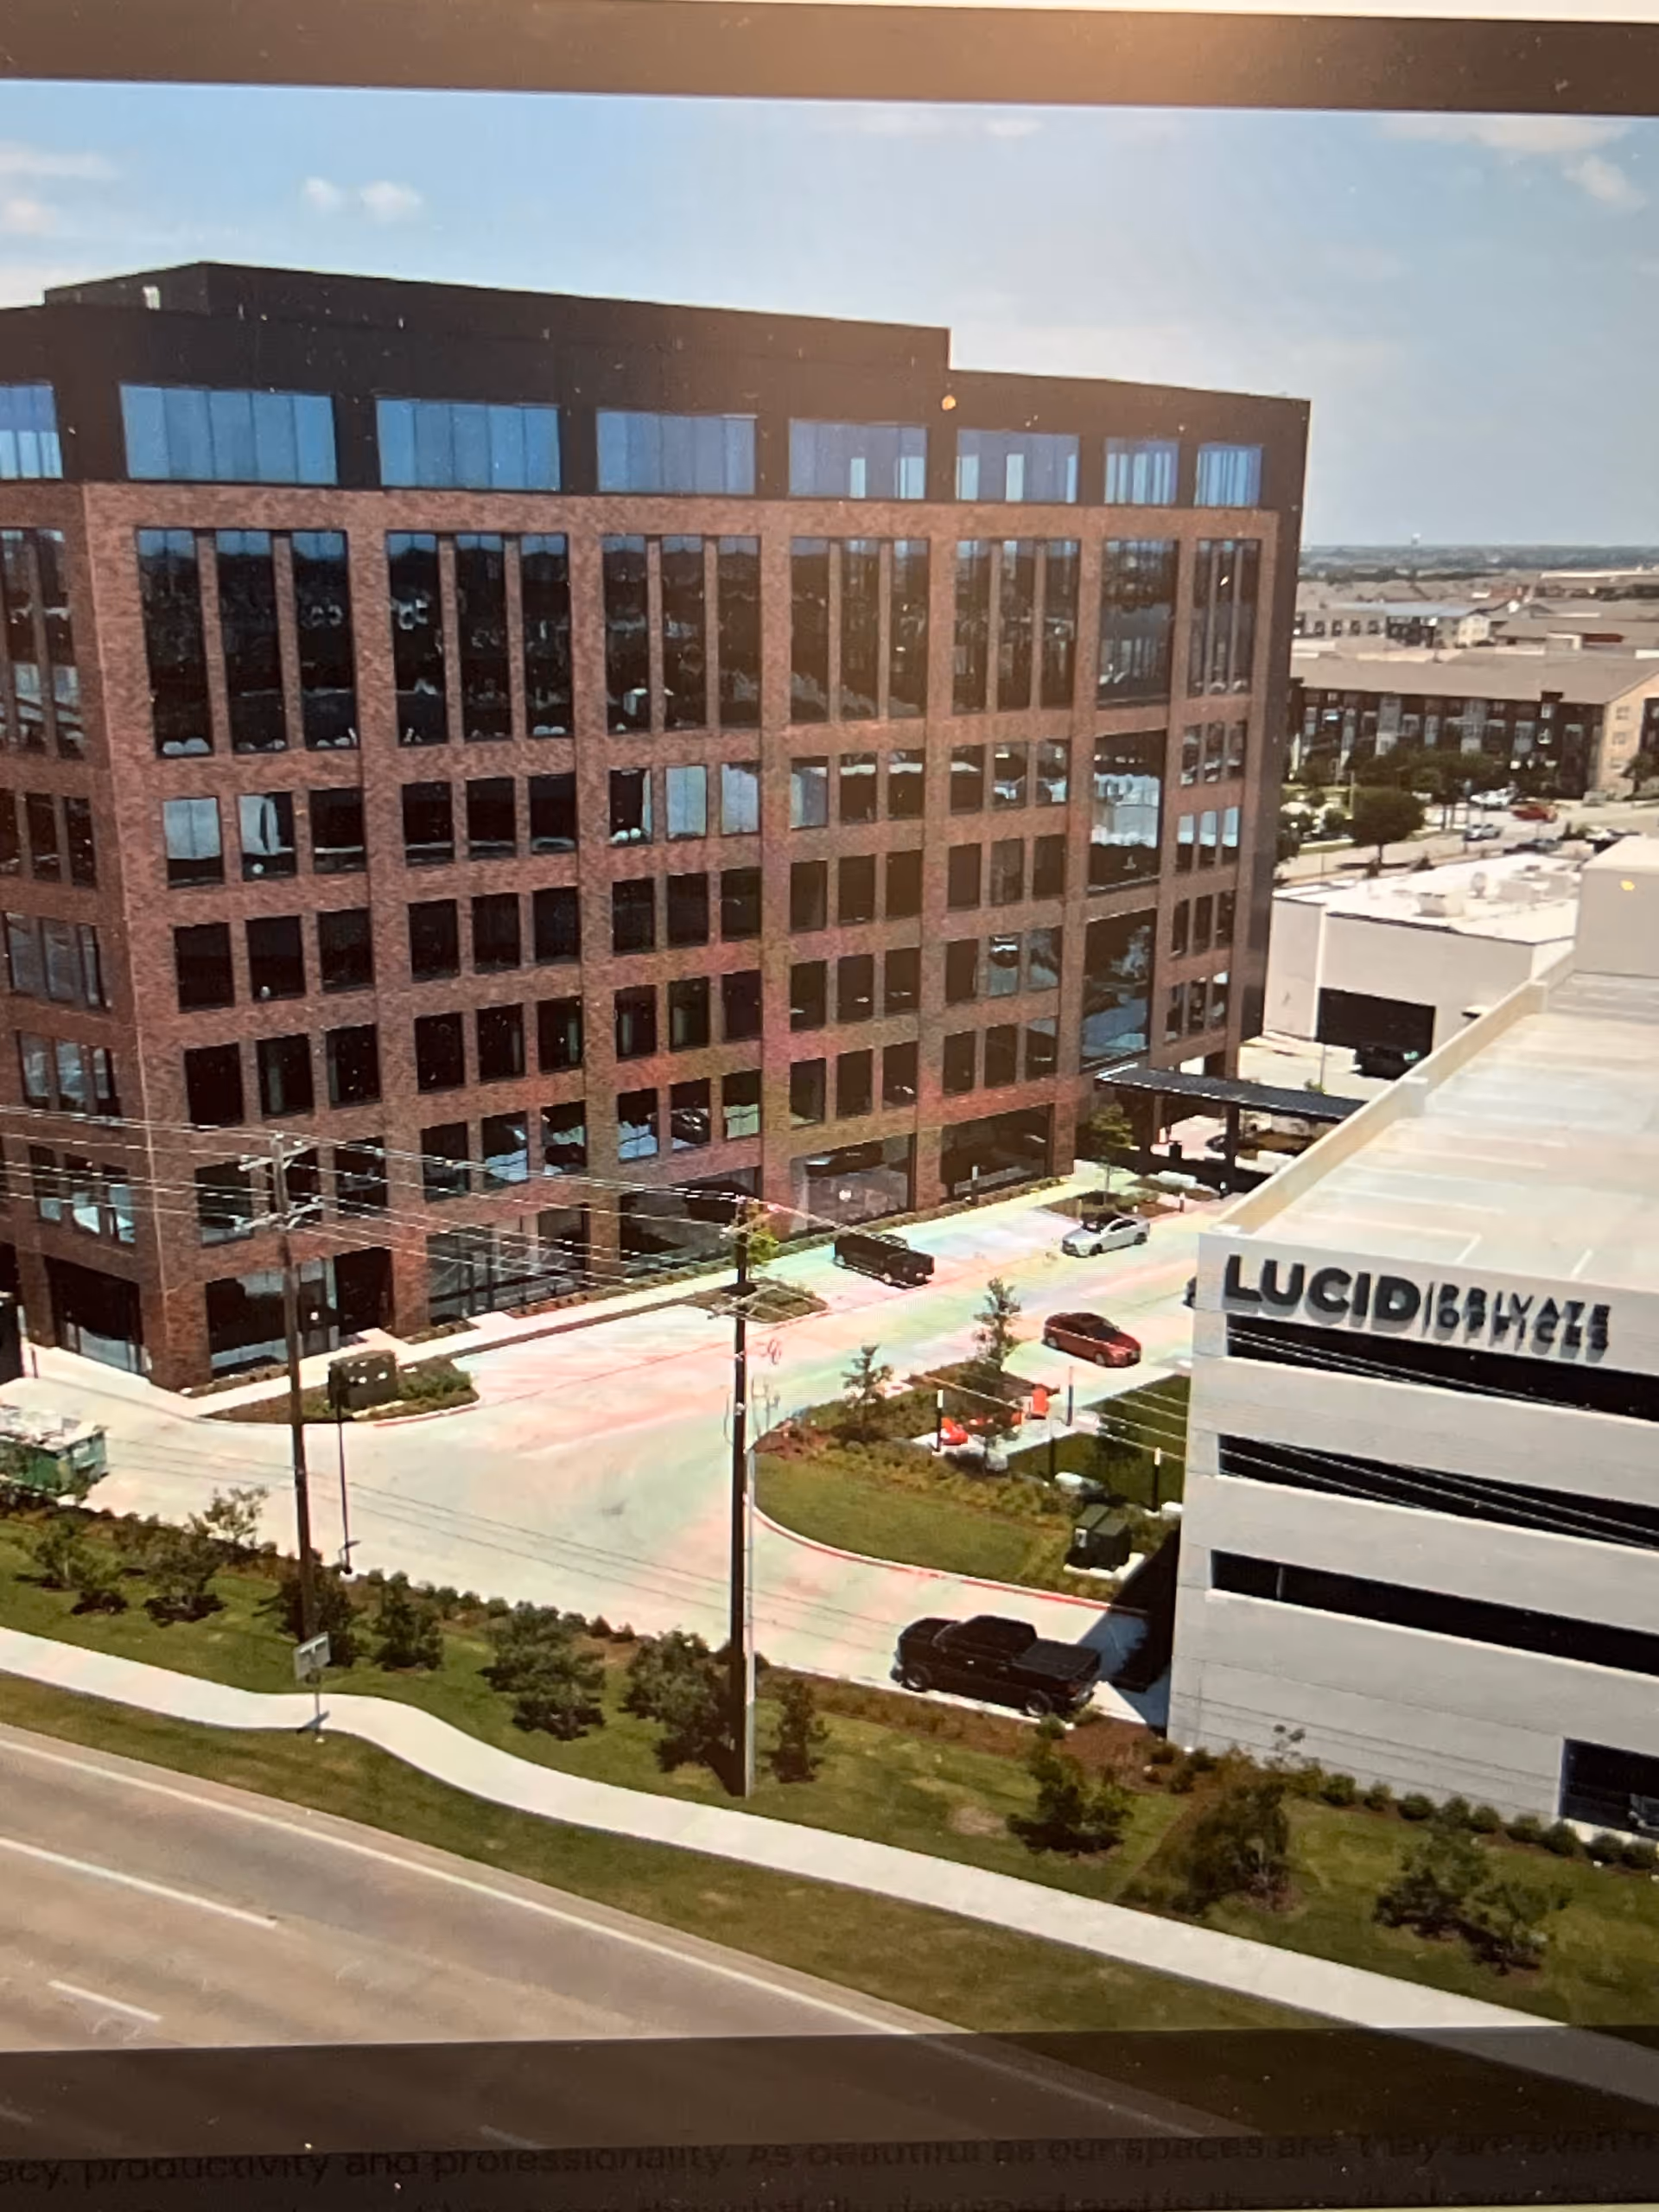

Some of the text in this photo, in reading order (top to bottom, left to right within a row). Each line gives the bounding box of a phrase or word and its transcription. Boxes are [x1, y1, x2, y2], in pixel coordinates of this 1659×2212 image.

[1222, 1254, 1611, 1328] LUCID PRIVATE
[1438, 1306, 1610, 1351] OFFICES
